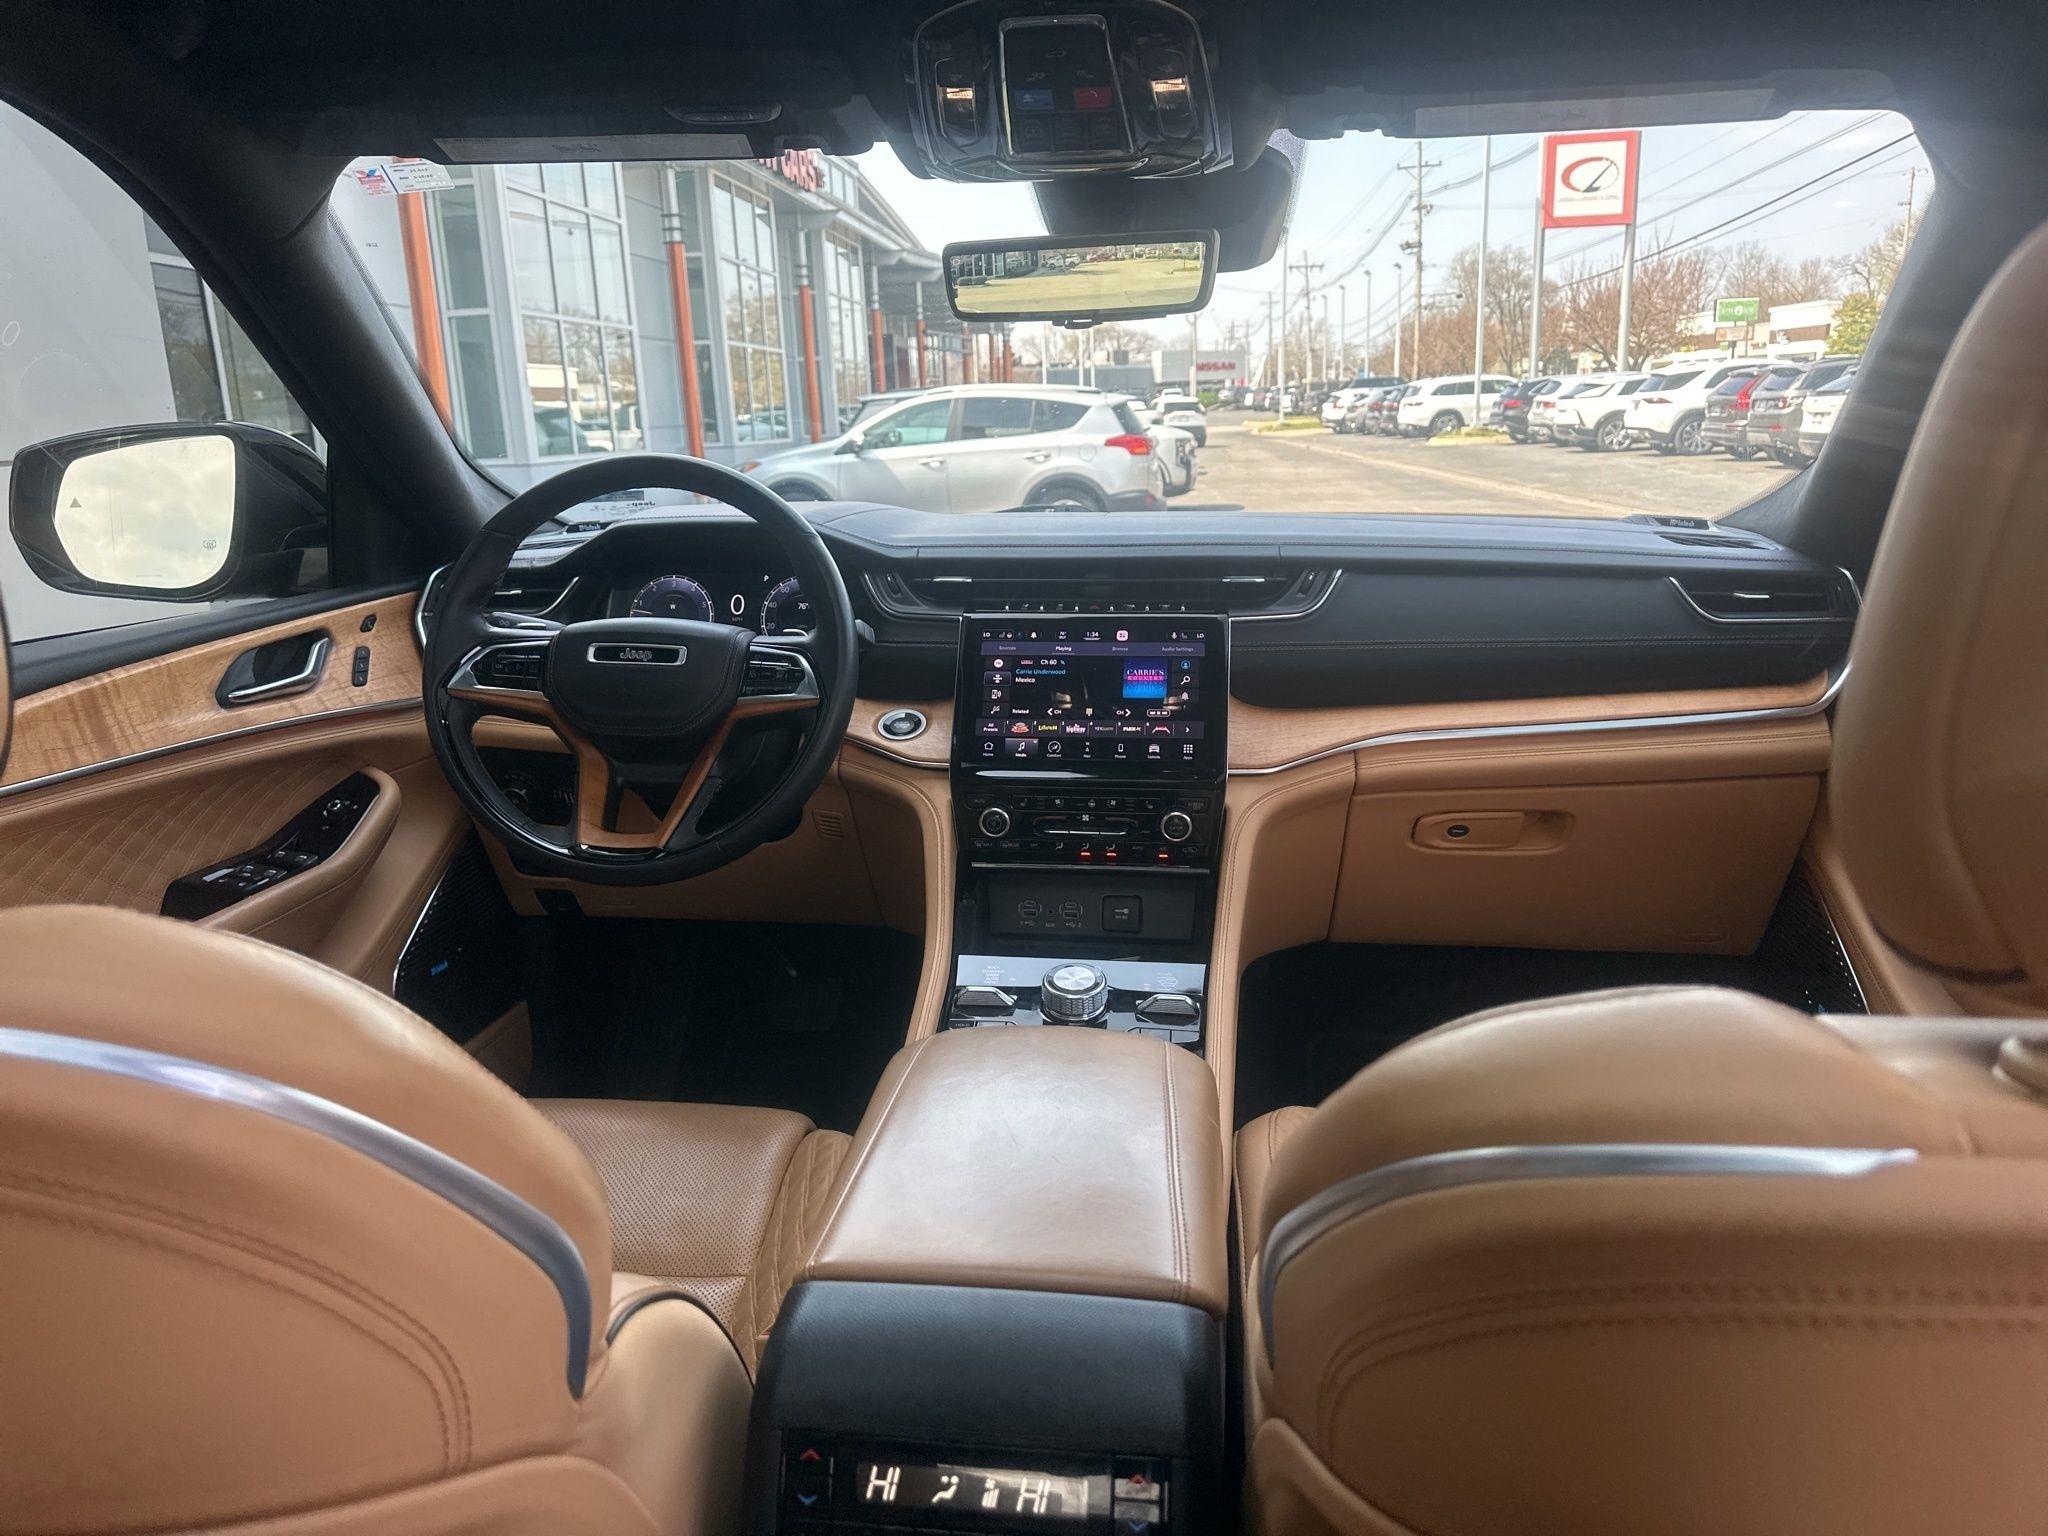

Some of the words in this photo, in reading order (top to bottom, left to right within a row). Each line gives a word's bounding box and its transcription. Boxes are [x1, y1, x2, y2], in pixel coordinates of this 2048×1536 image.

[730, 594, 745, 615] 0
[766, 622, 776, 630] 20
[619, 647, 653, 662] Jeep
[865, 1464, 901, 1502] HI
[1016, 1477, 1052, 1514] HI
